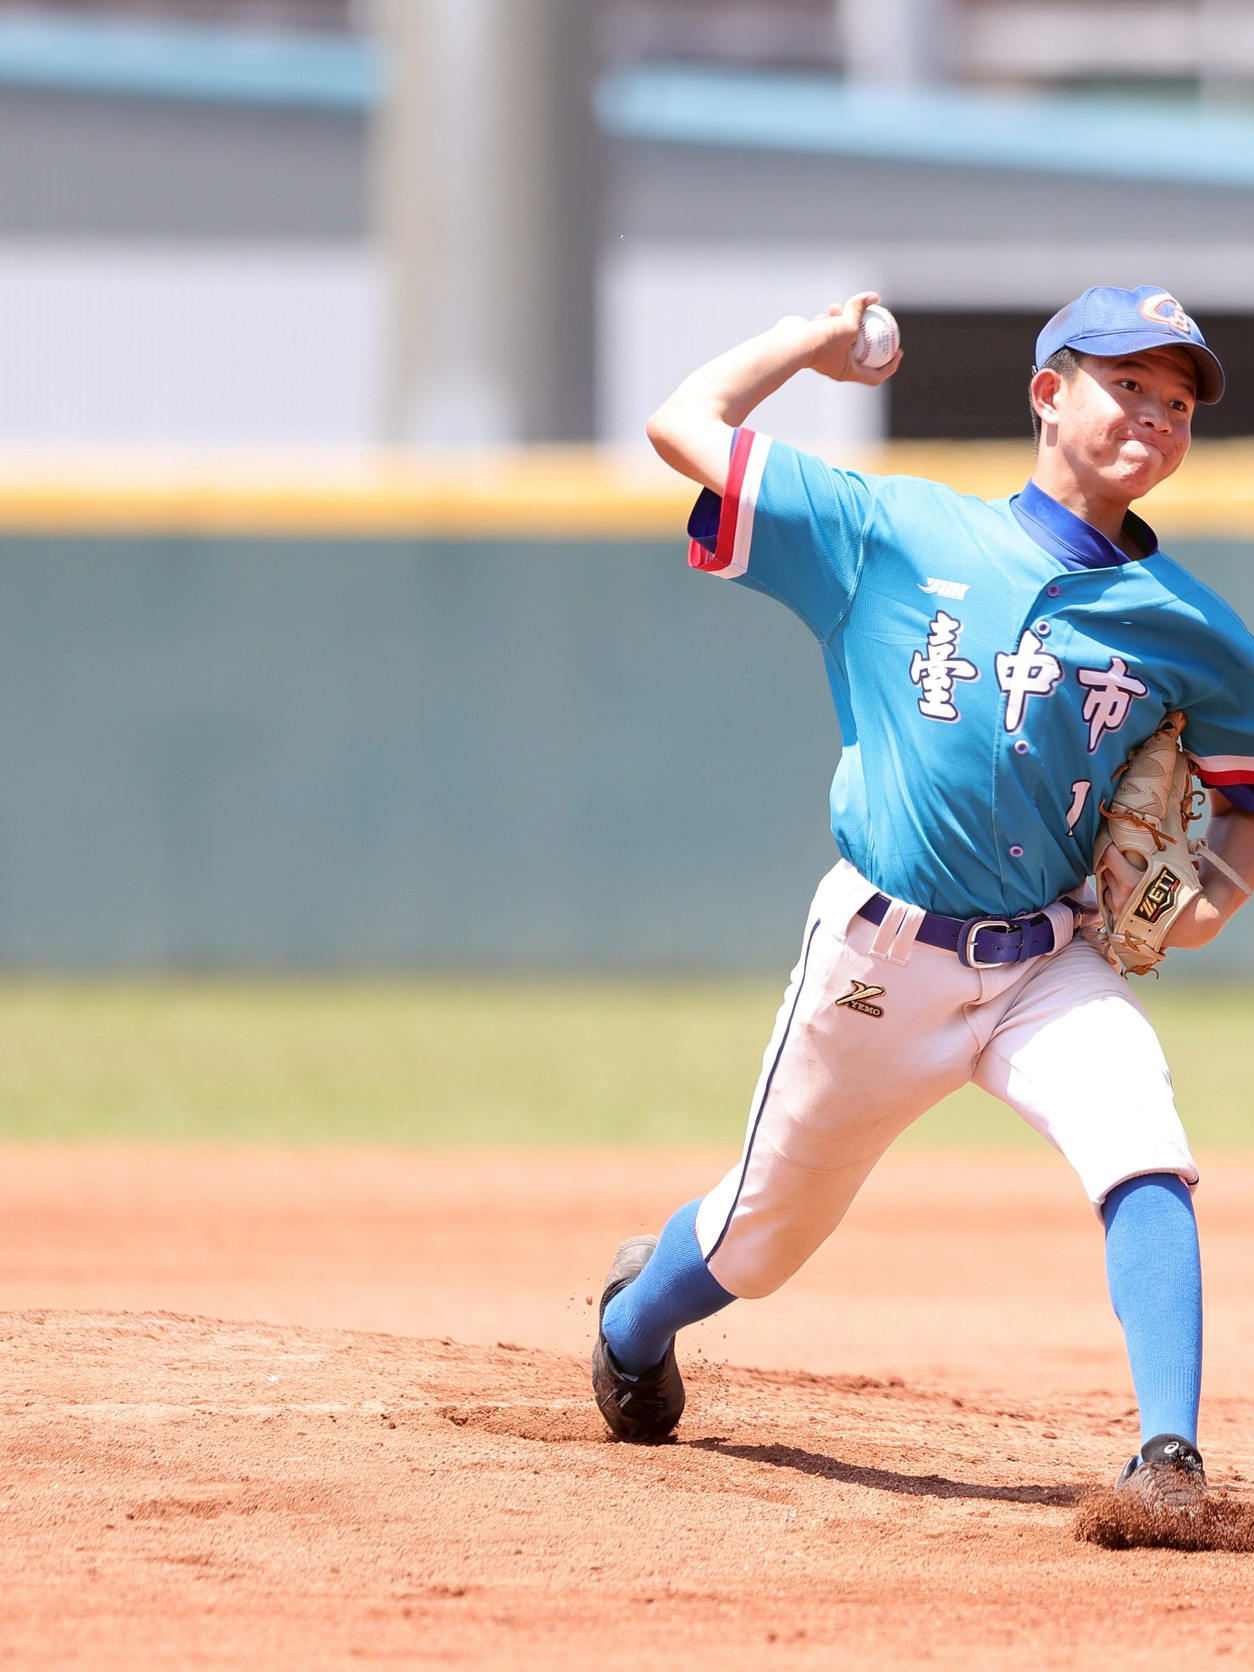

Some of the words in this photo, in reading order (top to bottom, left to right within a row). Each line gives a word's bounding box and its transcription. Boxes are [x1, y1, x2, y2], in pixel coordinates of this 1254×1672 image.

[911, 610, 1149, 755] 臺中市
[1139, 869, 1175, 918] ZETT
[850, 1000, 881, 1016] YEMO
